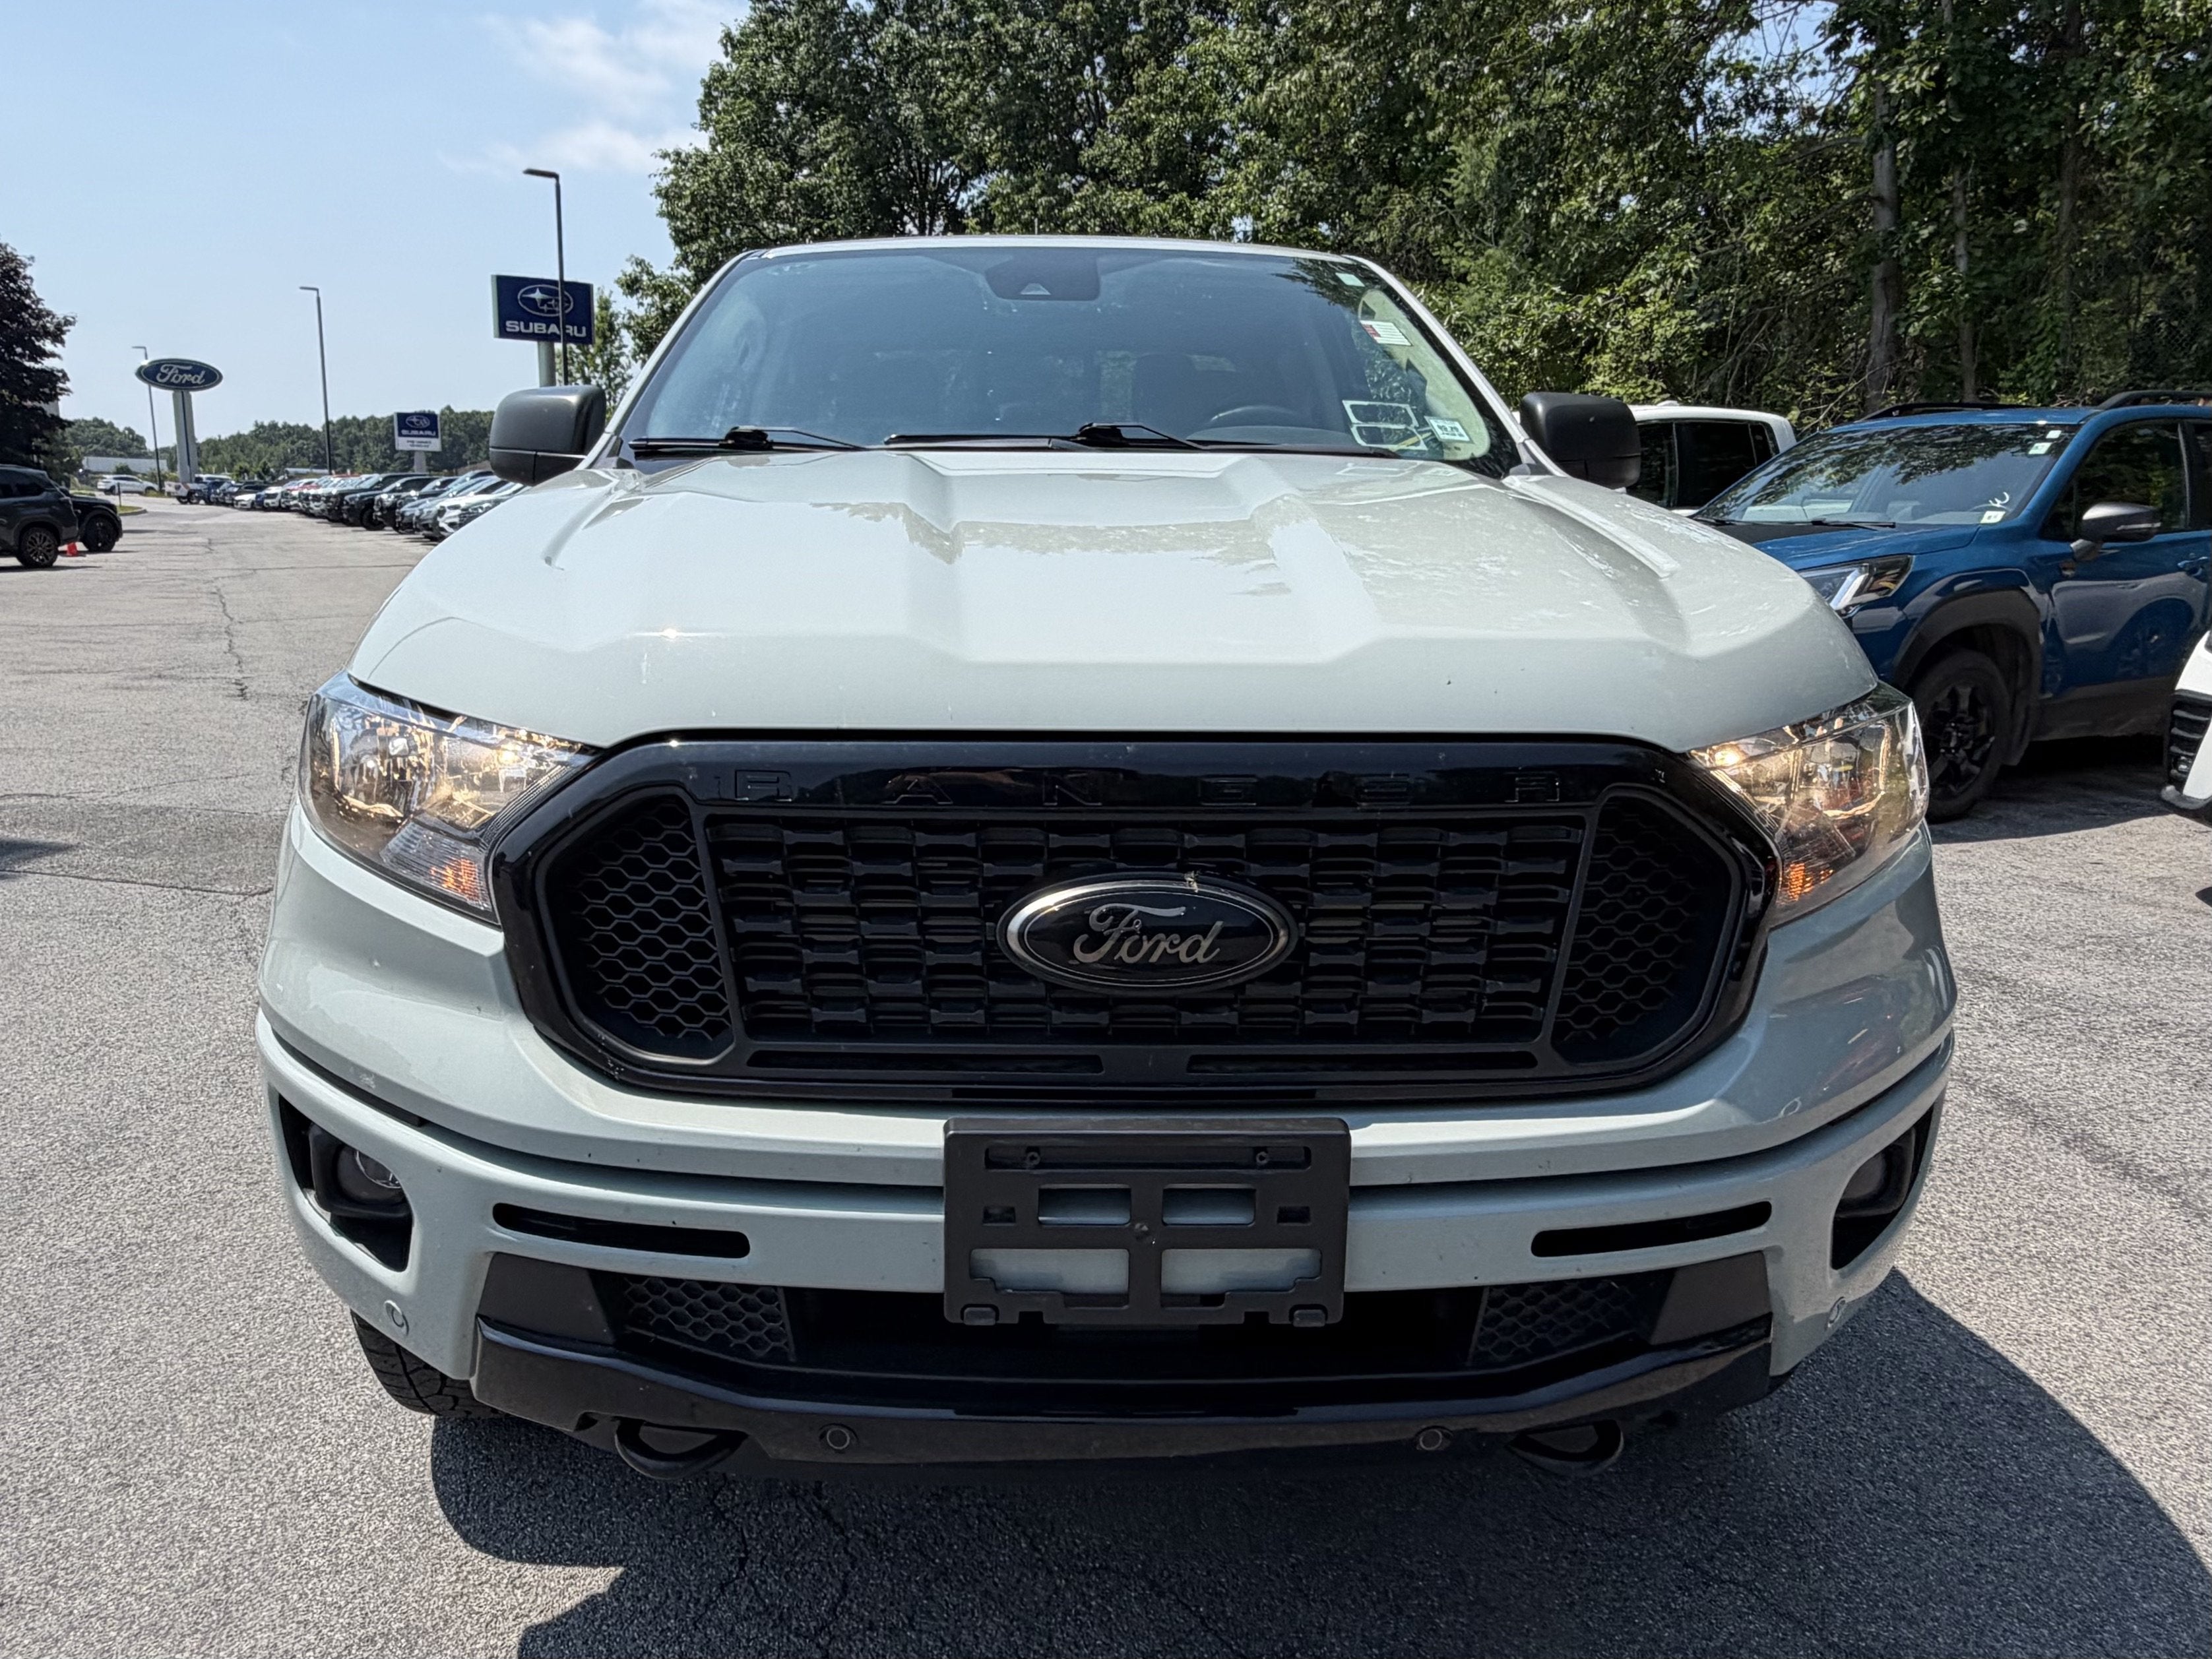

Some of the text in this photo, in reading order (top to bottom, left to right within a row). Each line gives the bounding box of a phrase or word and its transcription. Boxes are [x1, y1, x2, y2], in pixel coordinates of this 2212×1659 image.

[505, 320, 586, 338] SUBARU
[156, 363, 206, 384] Ford
[1073, 902, 1224, 964] Ford
